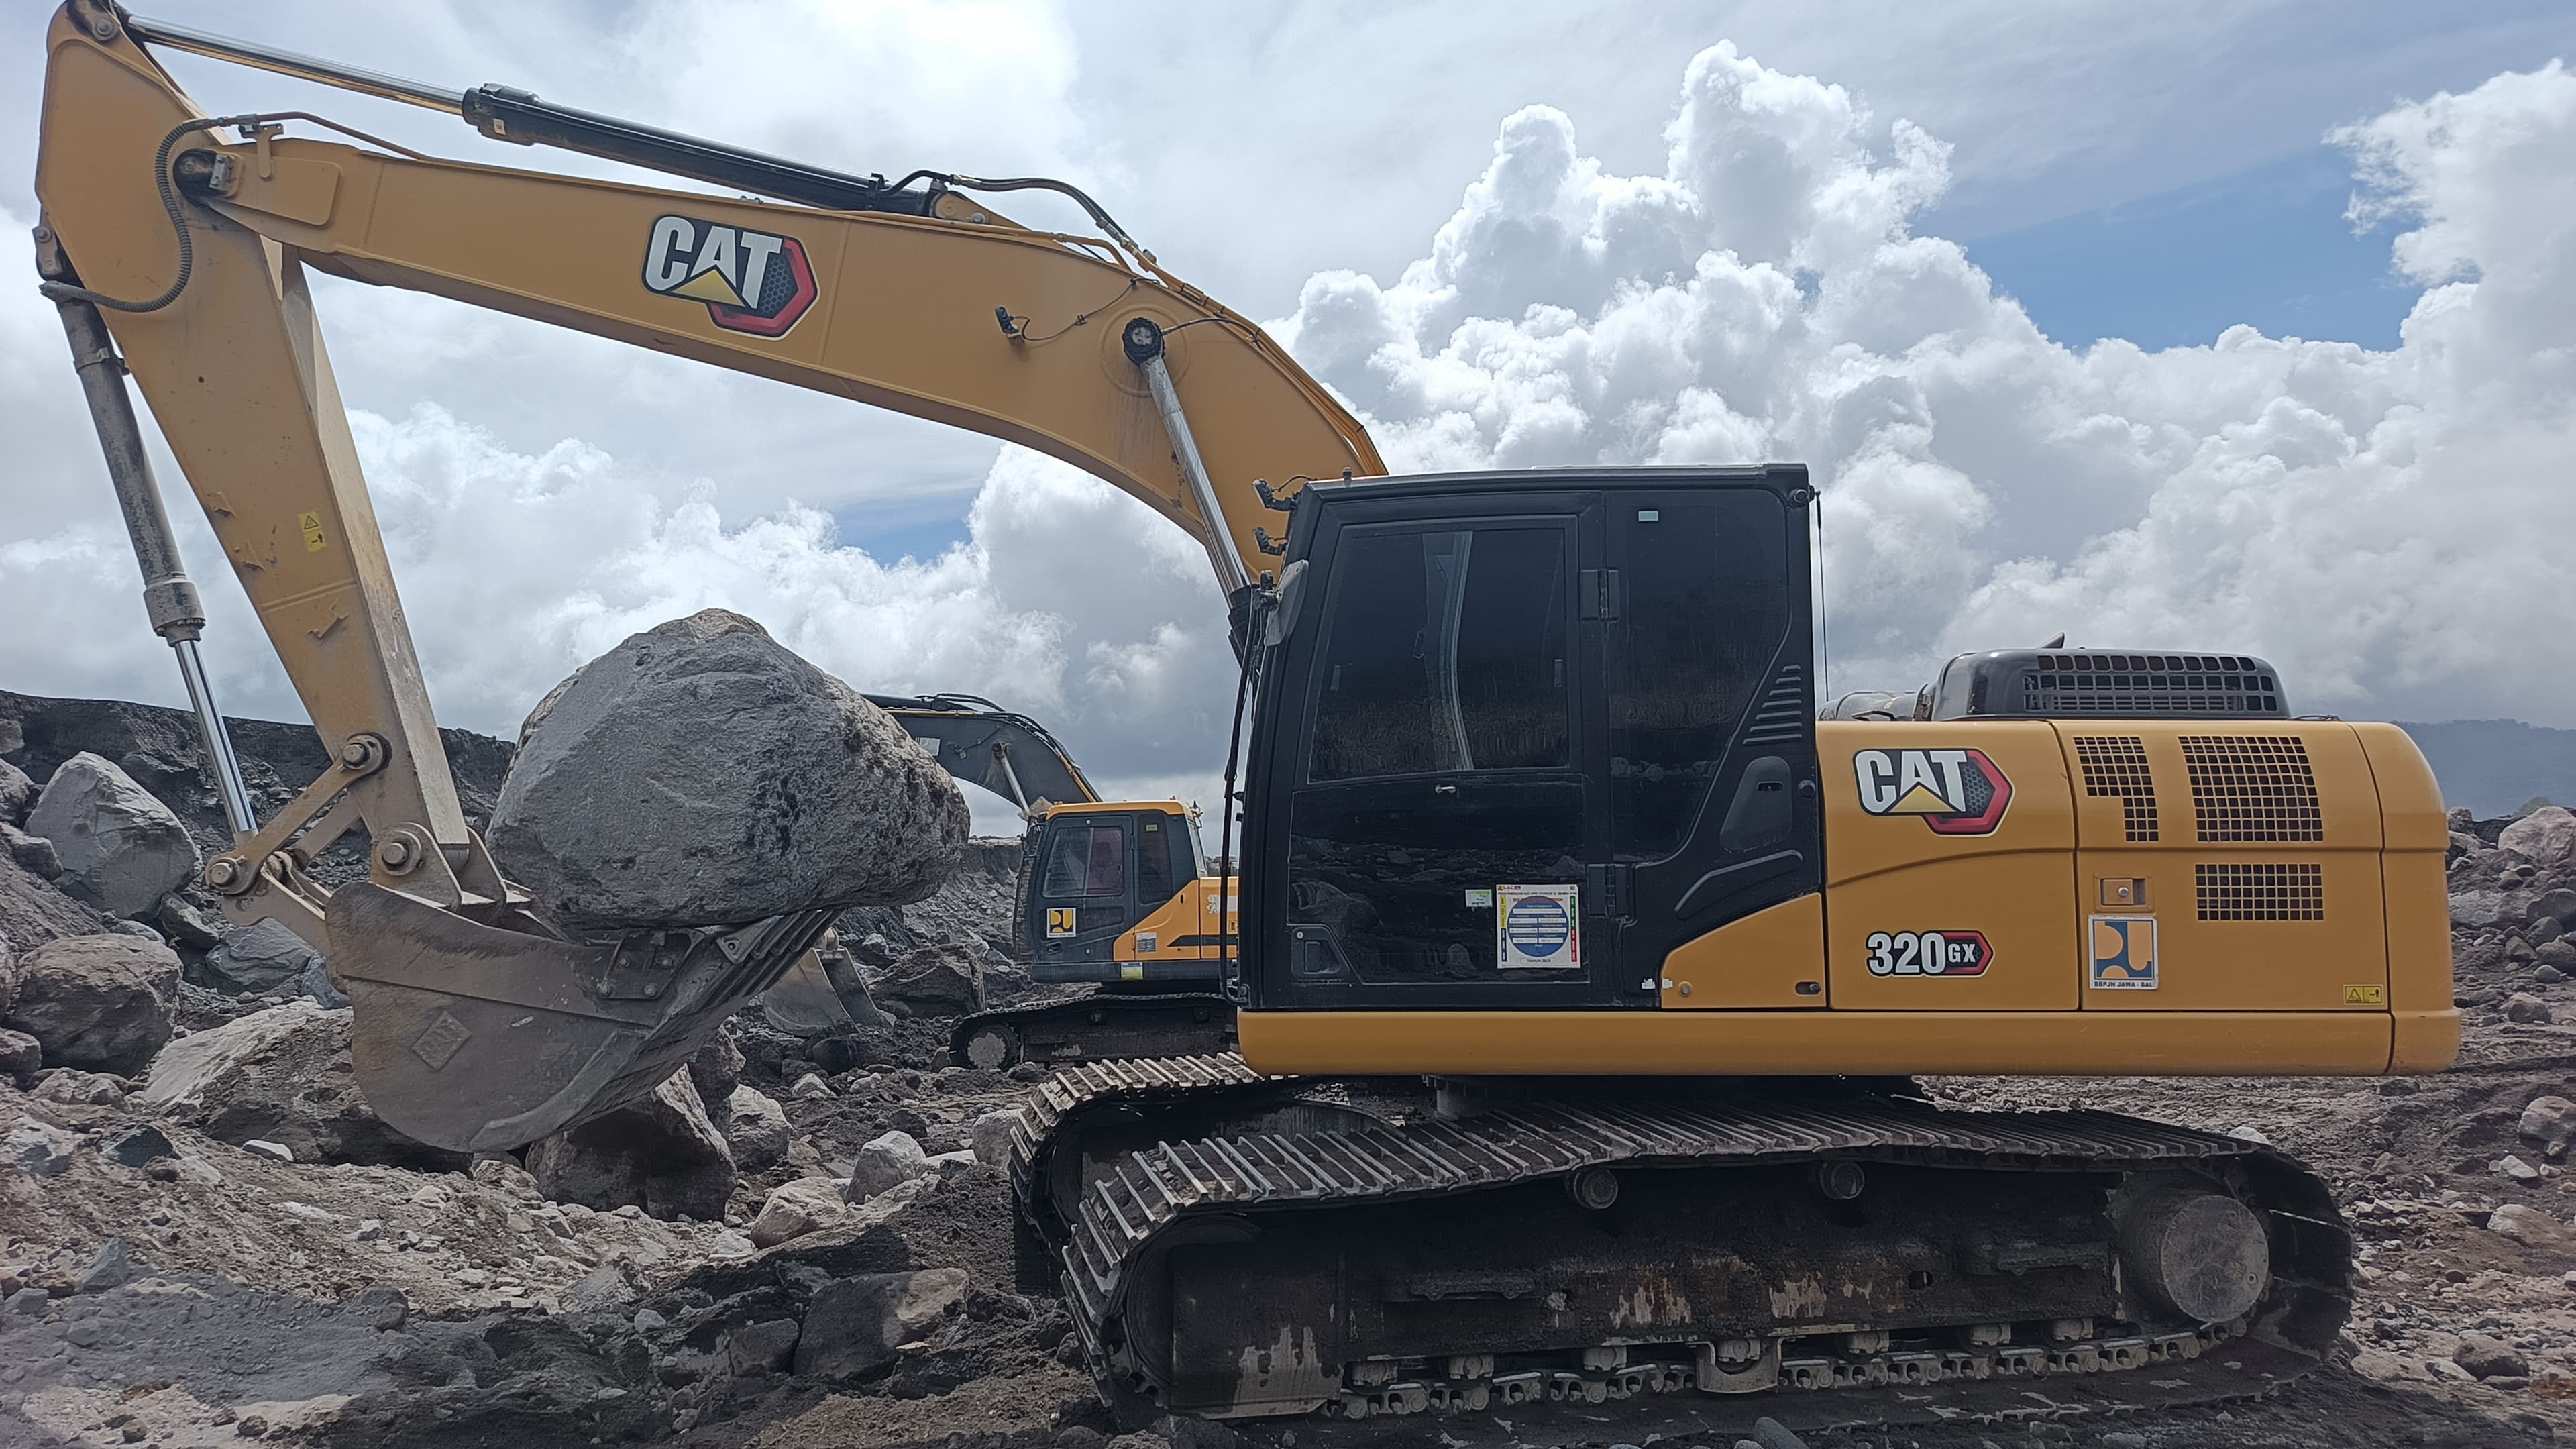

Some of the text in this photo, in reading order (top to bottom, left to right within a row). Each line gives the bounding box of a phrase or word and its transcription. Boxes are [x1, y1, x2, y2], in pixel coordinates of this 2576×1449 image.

[645, 216, 783, 309] CAT
[1855, 750, 1968, 813] CAT
[1868, 932, 1976, 973] 320 GX
